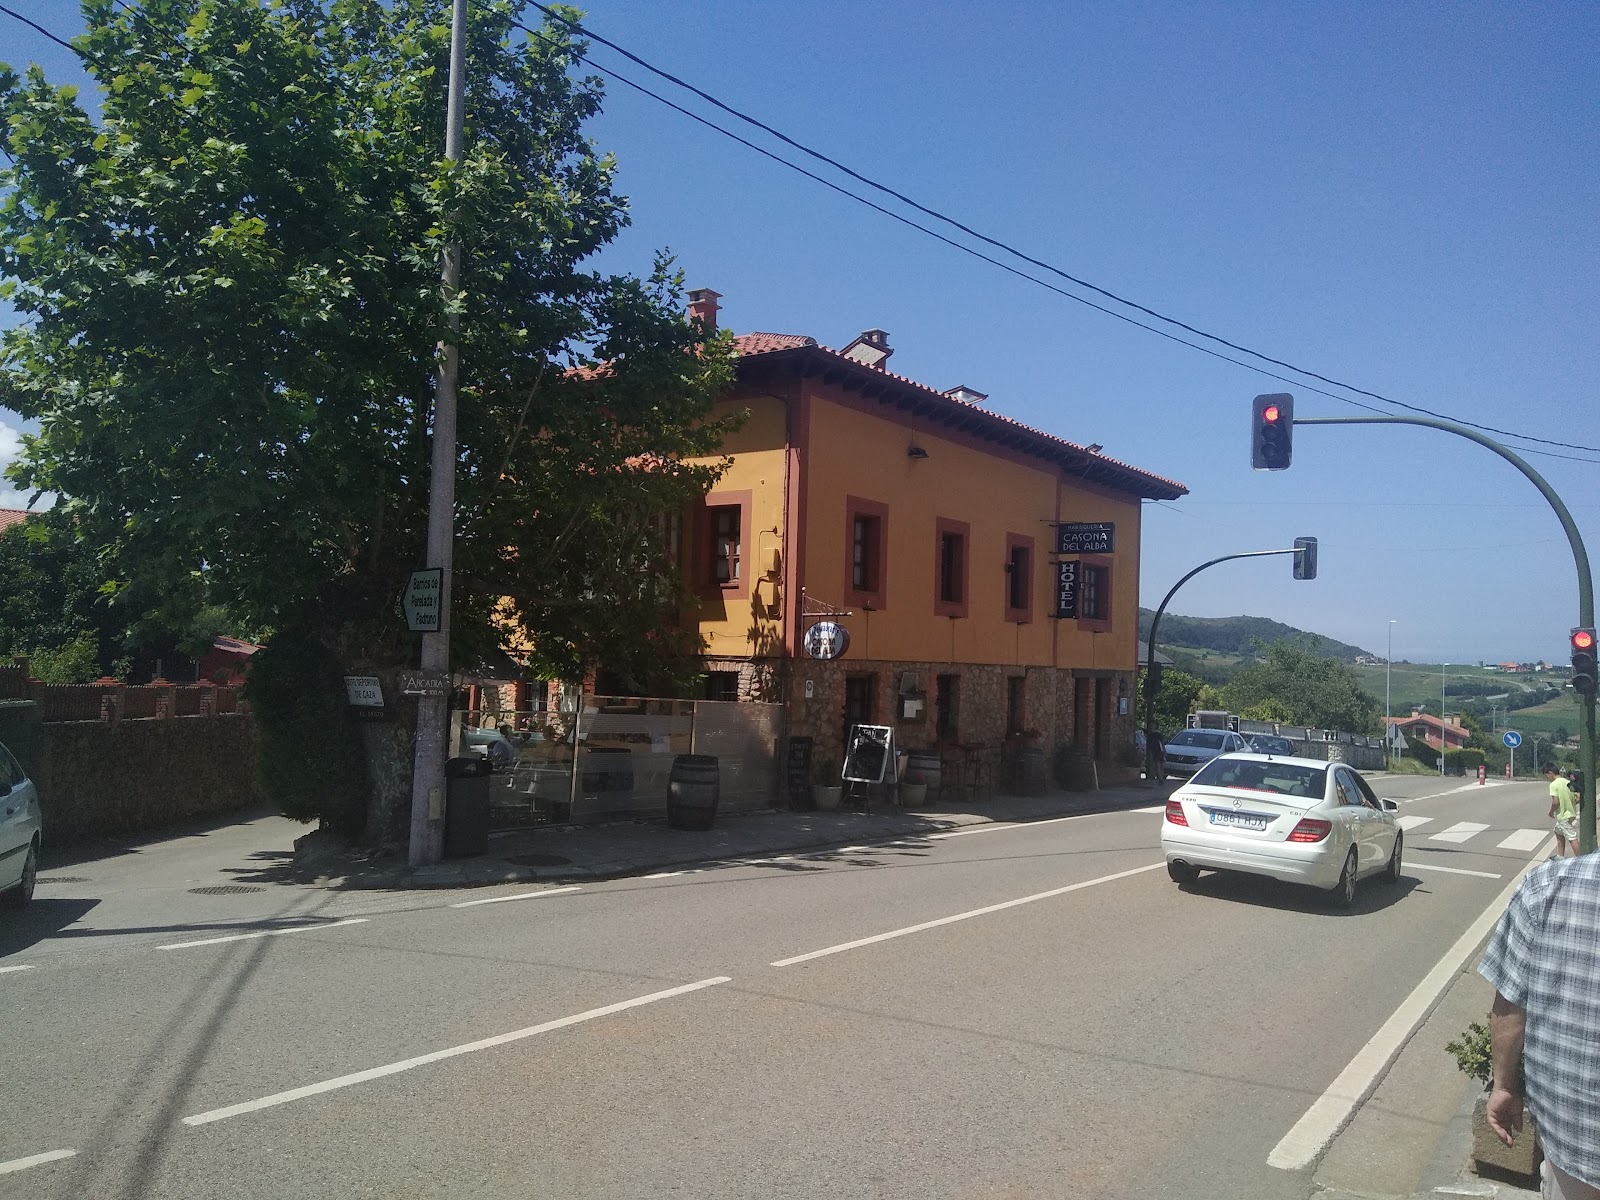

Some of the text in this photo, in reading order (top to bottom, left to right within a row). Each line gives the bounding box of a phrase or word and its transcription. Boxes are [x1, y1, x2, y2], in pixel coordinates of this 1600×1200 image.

[1063, 532, 1108, 542] CASONA
[1063, 541, 1107, 551] DEL ALBA
[413, 576, 438, 590] Barrios de
[1060, 563, 1075, 609] HOTEL
[406, 677, 443, 688] ARCADIA
[1217, 812, 1241, 824] 0861
[1244, 816, 1264, 827] HJX
